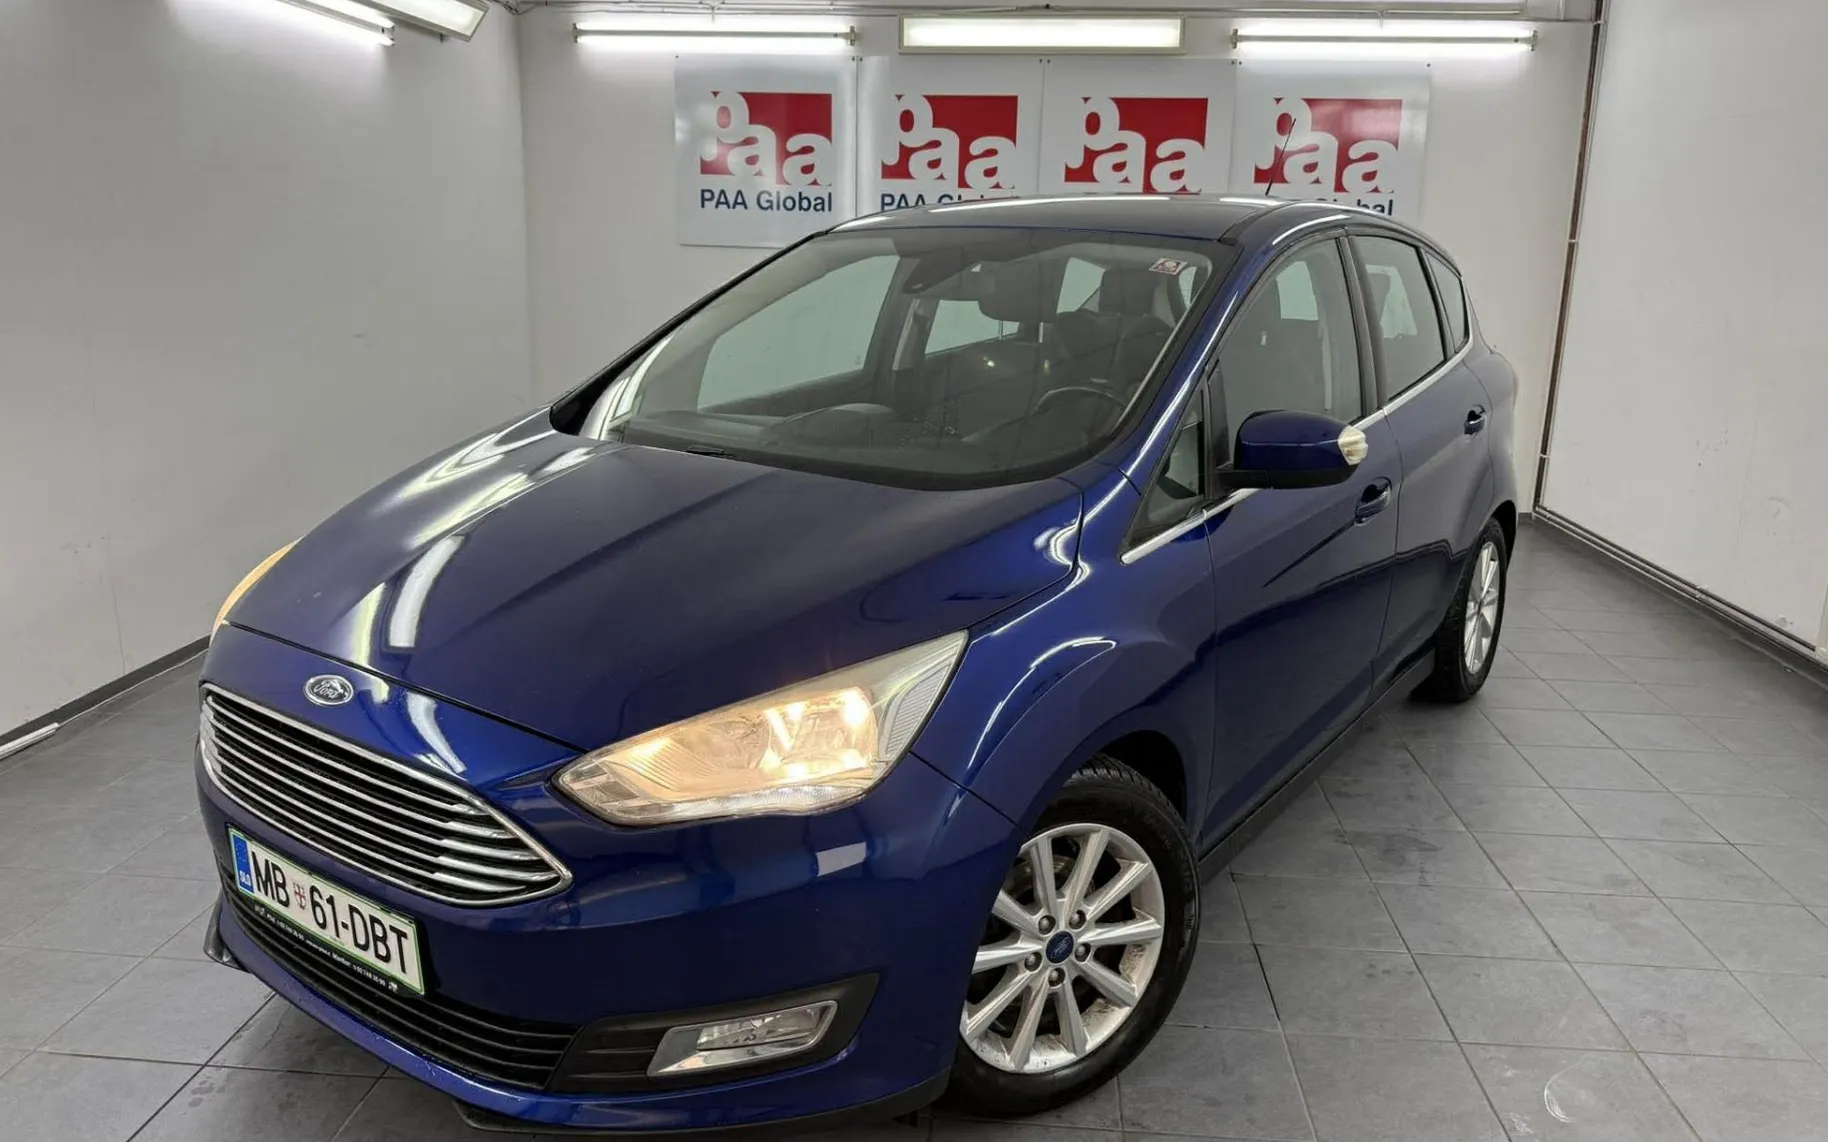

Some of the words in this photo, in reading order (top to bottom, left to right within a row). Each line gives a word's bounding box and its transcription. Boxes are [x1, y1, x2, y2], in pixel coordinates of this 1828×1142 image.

[700, 188, 749, 210] PAA
[756, 189, 833, 212] Global
[251, 850, 290, 908] MB
[309, 884, 409, 974] 61-DBT
